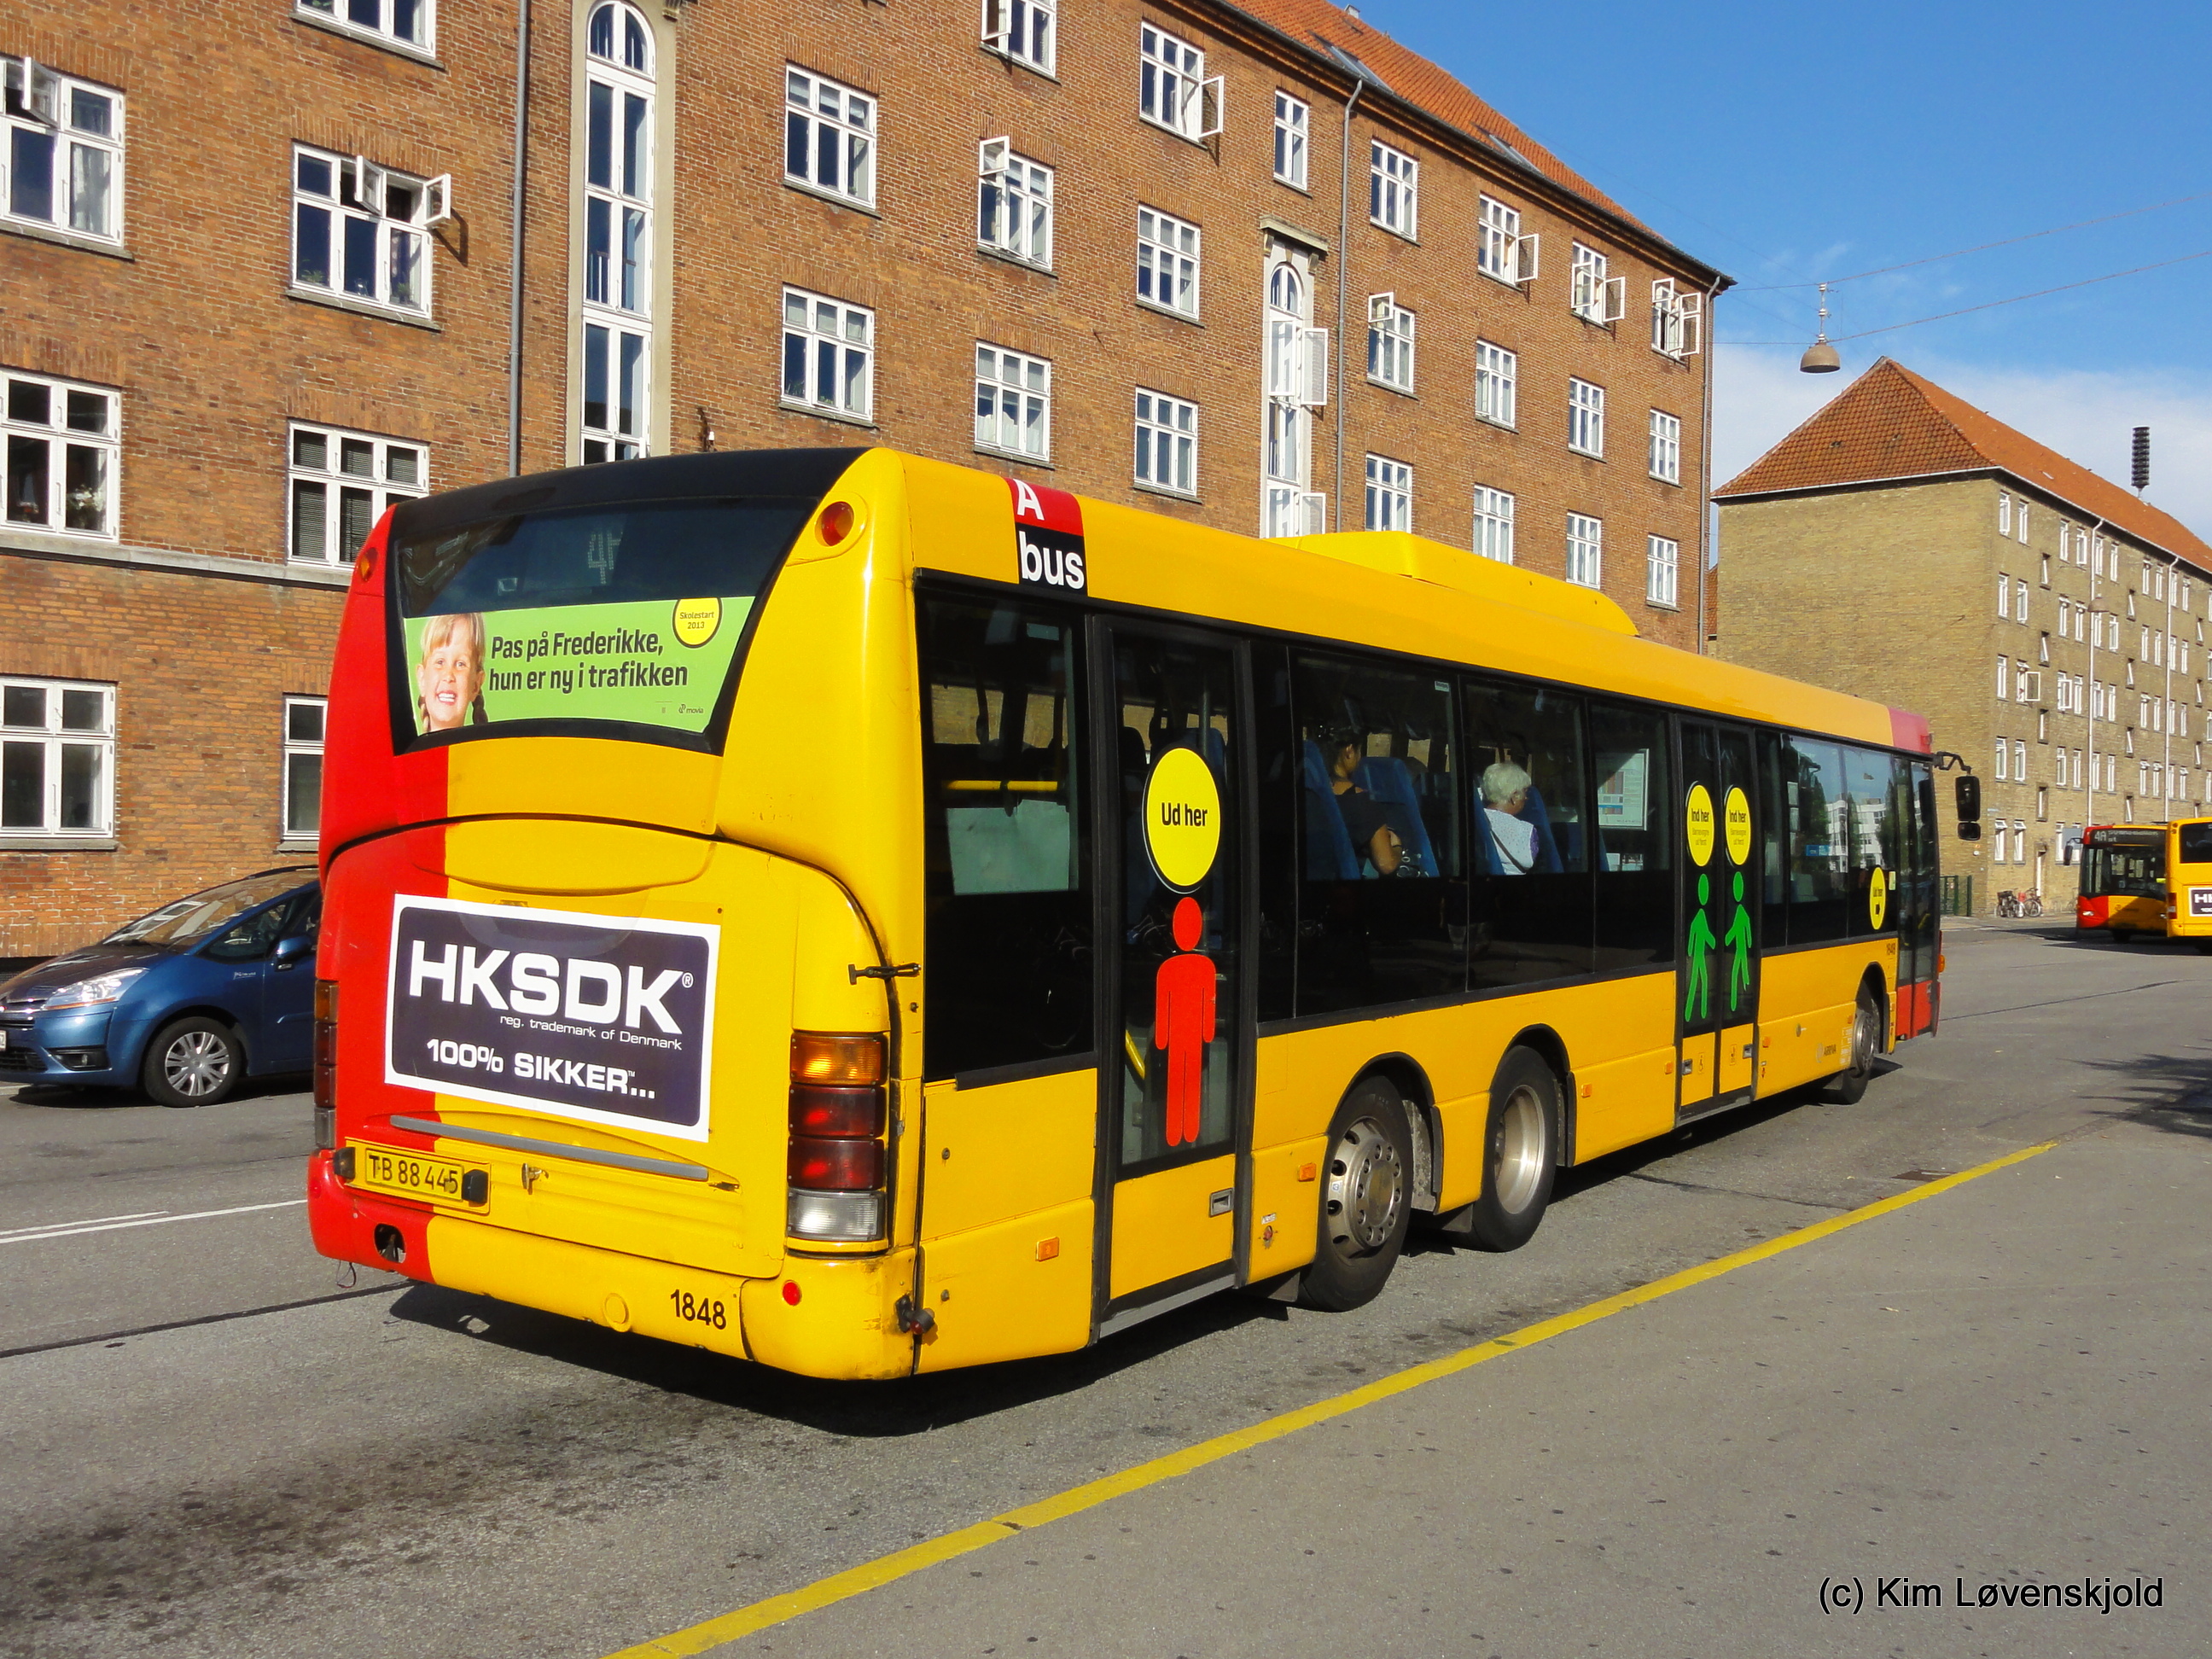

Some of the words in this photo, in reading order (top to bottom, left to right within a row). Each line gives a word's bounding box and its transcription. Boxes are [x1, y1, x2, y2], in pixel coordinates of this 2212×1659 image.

[1013, 479, 1045, 520] A
[1019, 530, 1085, 590] bus
[679, 611, 715, 620] Skolestart
[687, 621, 705, 630] 2013
[491, 636, 523, 660] Pas
[526, 631, 550, 661] på
[552, 626, 664, 657] Frederikke,
[489, 667, 522, 691] hun
[527, 668, 546, 690] er
[550, 669, 573, 695] ny
[578, 661, 584, 688] i
[587, 661, 688, 688] trafikken
[1161, 801, 1181, 826] Ud
[1185, 802, 1208, 827] her
[1701, 808, 1709, 823] her
[2094, 830, 2107, 841] 4A
[500, 1015, 524, 1027] reg.
[529, 1018, 597, 1038] trademark
[601, 1029, 615, 1040] of
[620, 1031, 683, 1051] Denmark
[427, 1039, 504, 1073] 100%
[369, 1155, 393, 1180] TB
[398, 1160, 420, 1186] 88
[425, 1166, 458, 1194] 445
[670, 1289, 727, 1330] 1848
